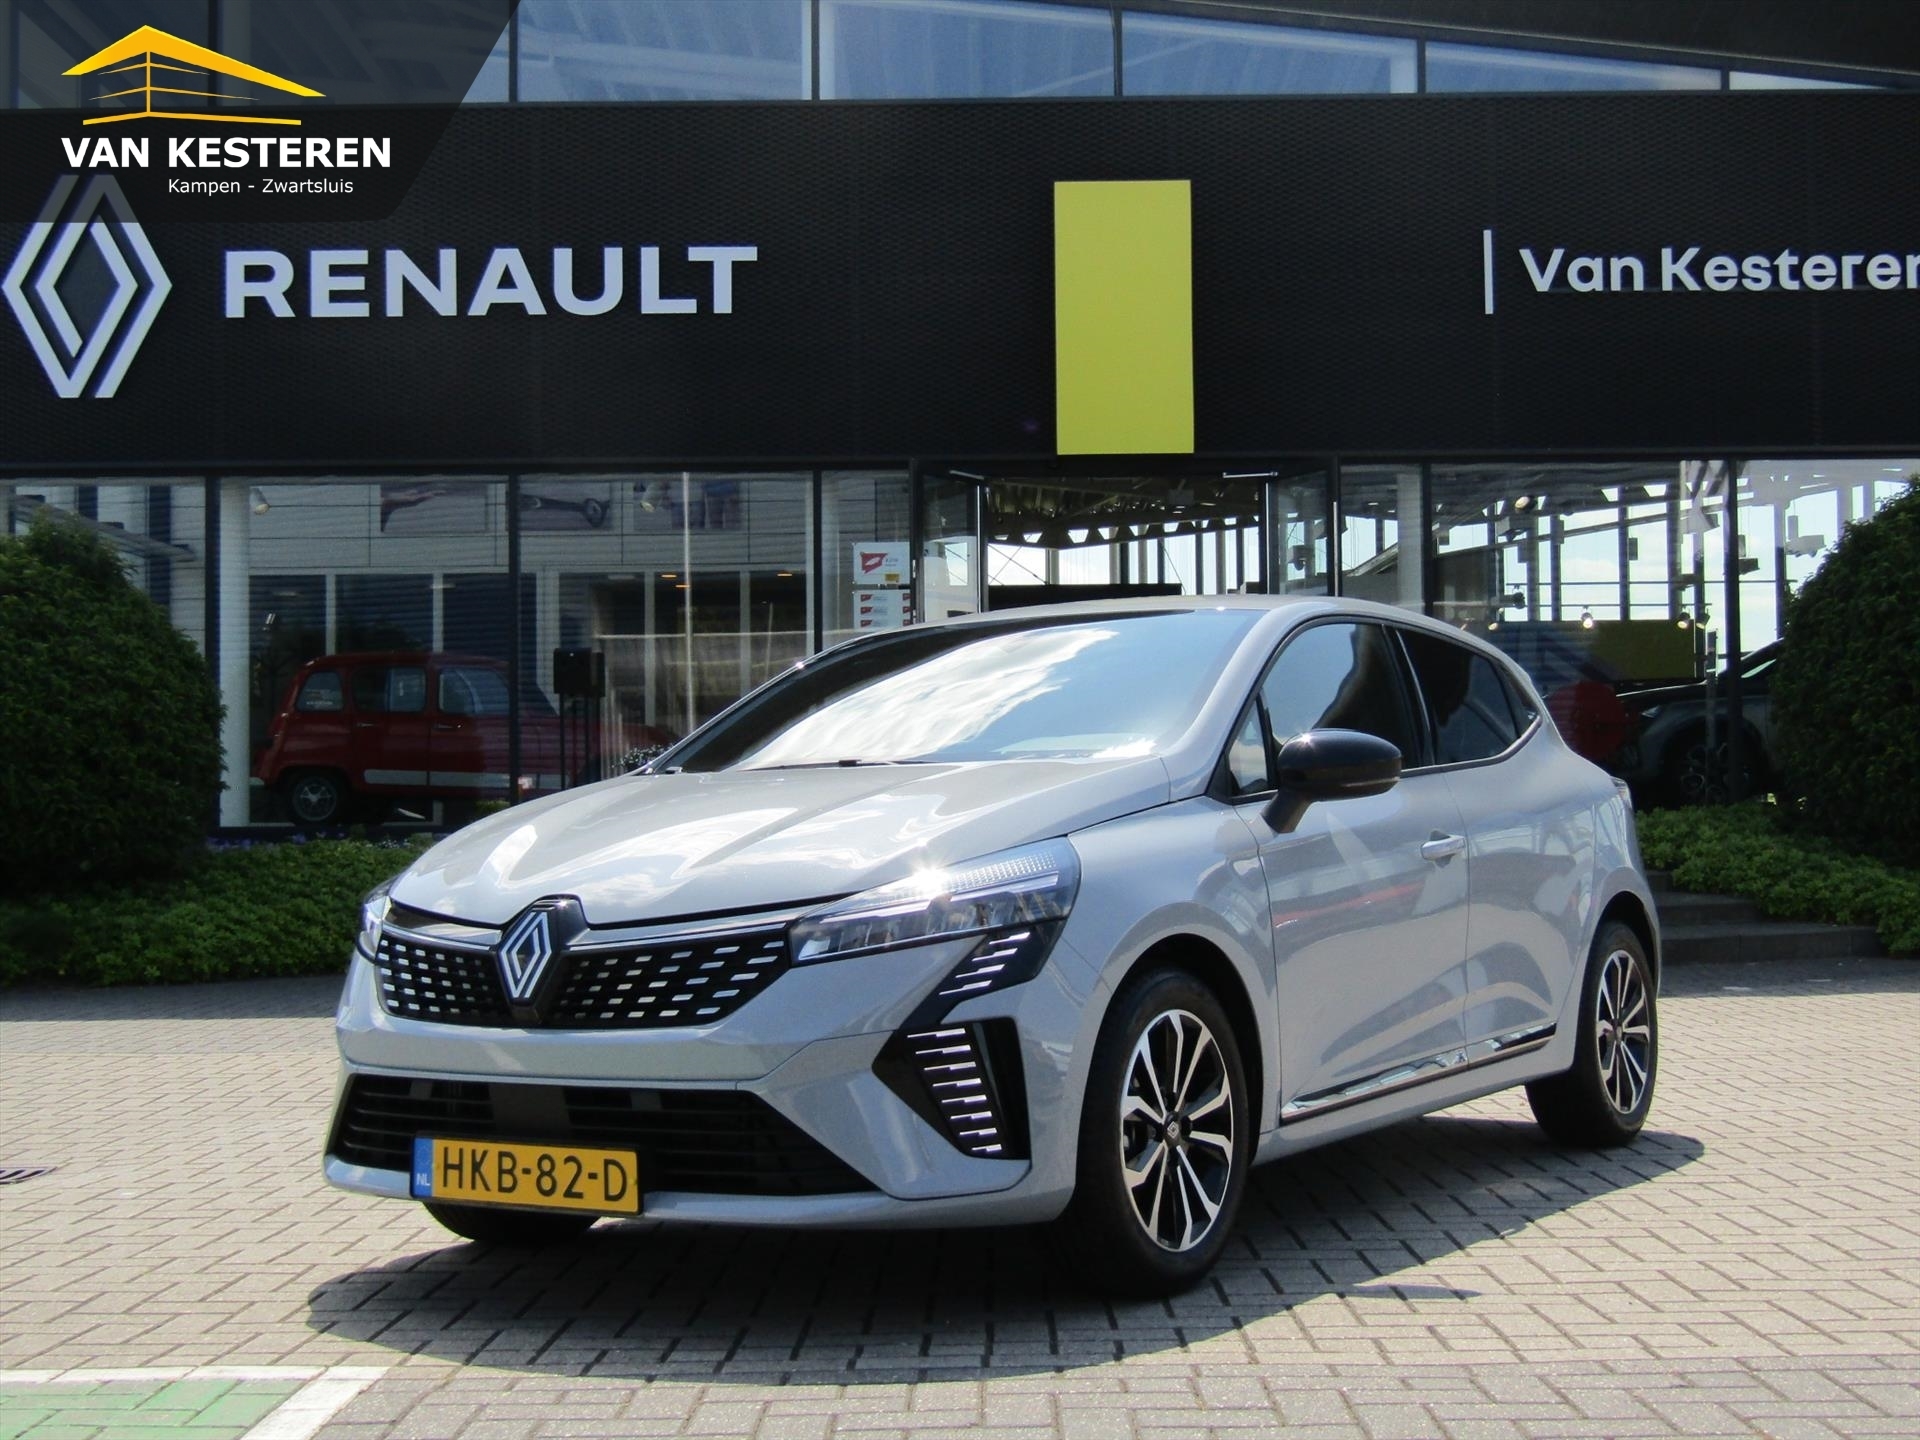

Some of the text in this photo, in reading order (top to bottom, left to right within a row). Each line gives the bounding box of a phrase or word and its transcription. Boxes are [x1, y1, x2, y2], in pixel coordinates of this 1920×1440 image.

[224, 245, 758, 319] RENAULT
[1519, 247, 1645, 292] Van
[416, 1172, 431, 1187] NL
[442, 1146, 628, 1202] HKB-82-D
